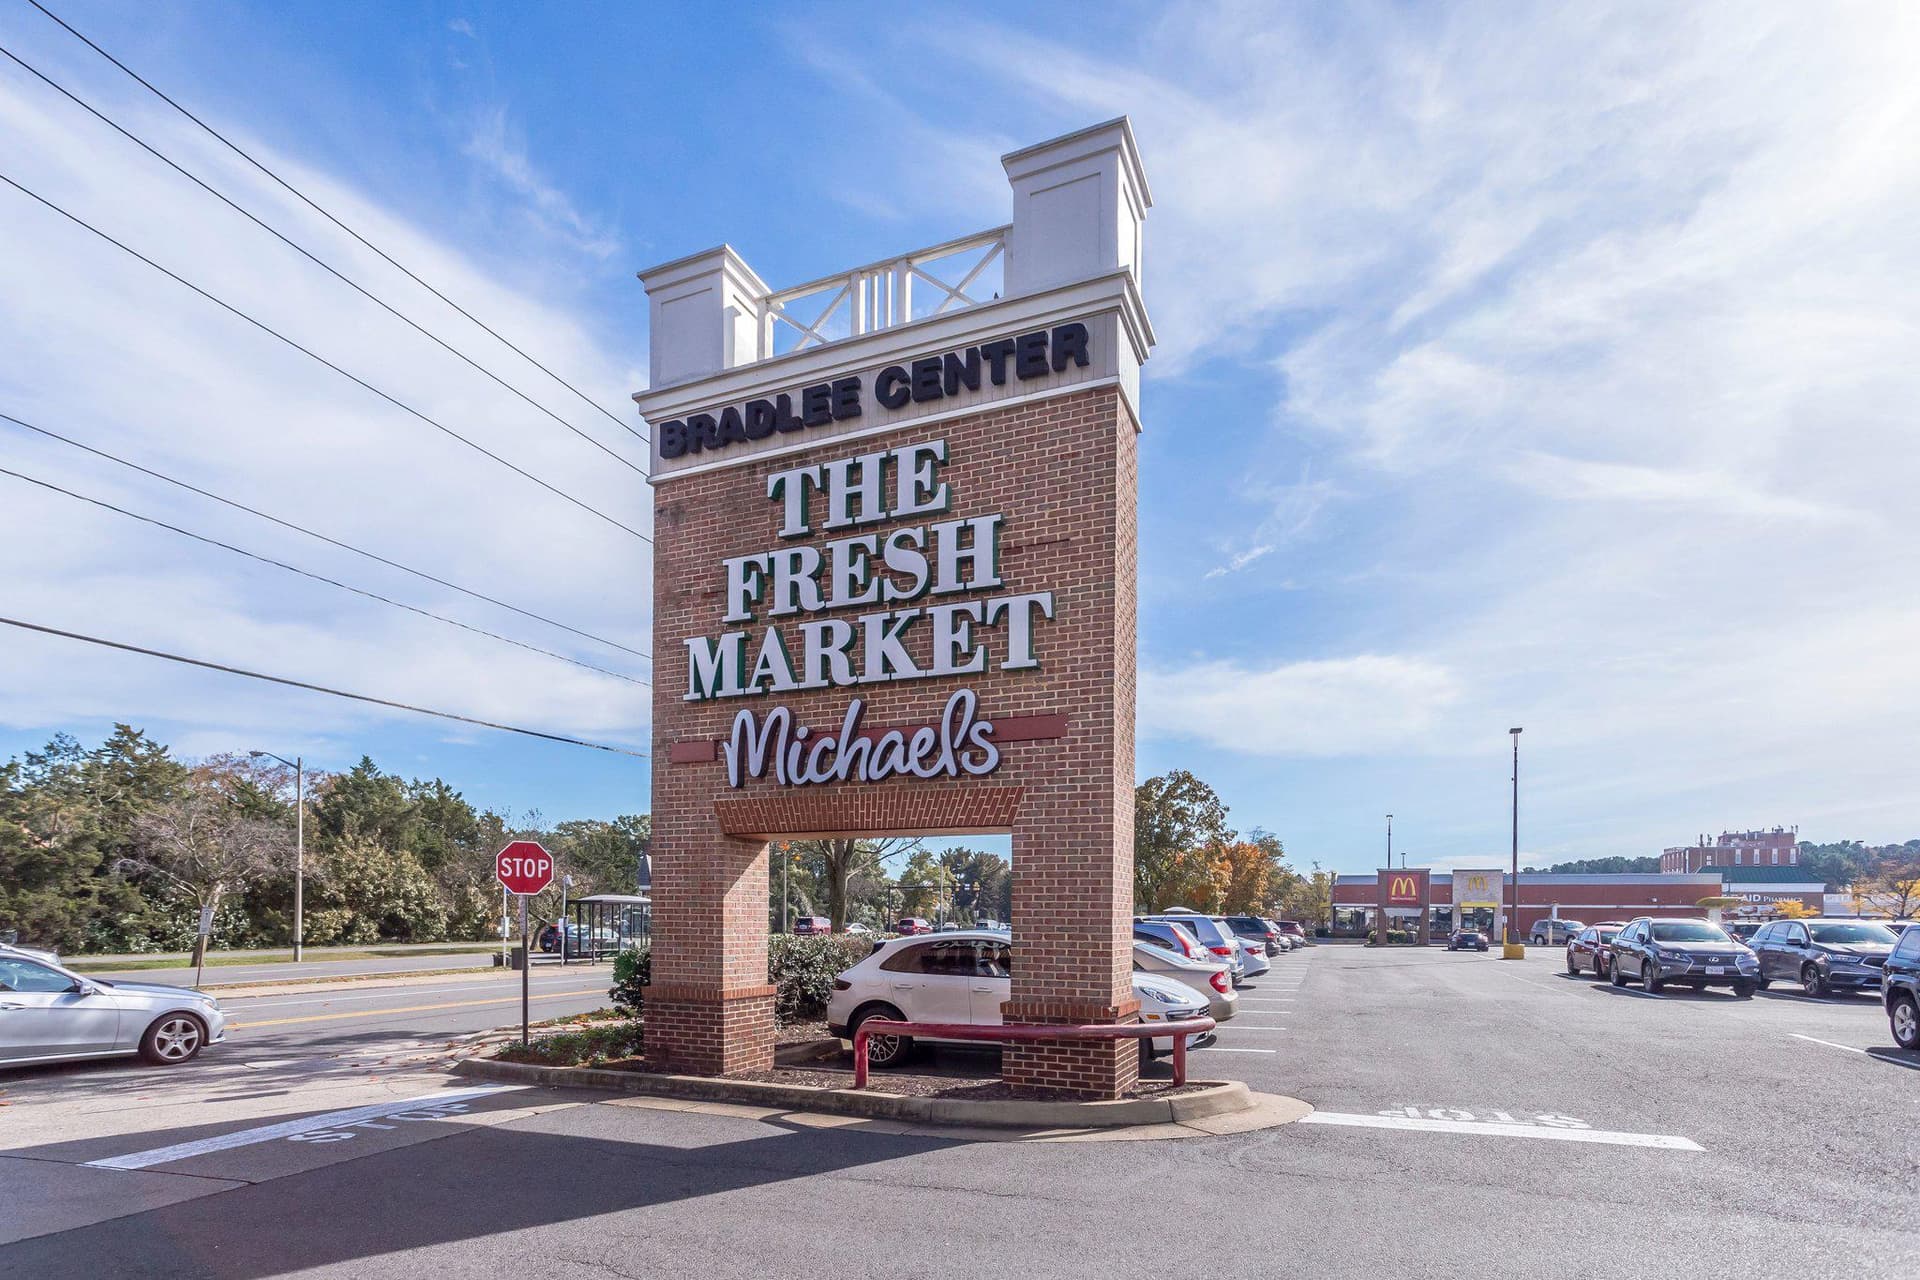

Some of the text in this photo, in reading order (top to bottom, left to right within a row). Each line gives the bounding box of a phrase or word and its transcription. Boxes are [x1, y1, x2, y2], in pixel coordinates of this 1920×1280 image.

[659, 322, 1090, 460] BRADLEE CENTER
[767, 438, 952, 540] THE
[722, 513, 1004, 624] FRESH
[682, 591, 1055, 702] MARKET
[723, 688, 1001, 788] Michaels
[500, 857, 550, 879] STOP
[287, 1103, 471, 1143] STOP
